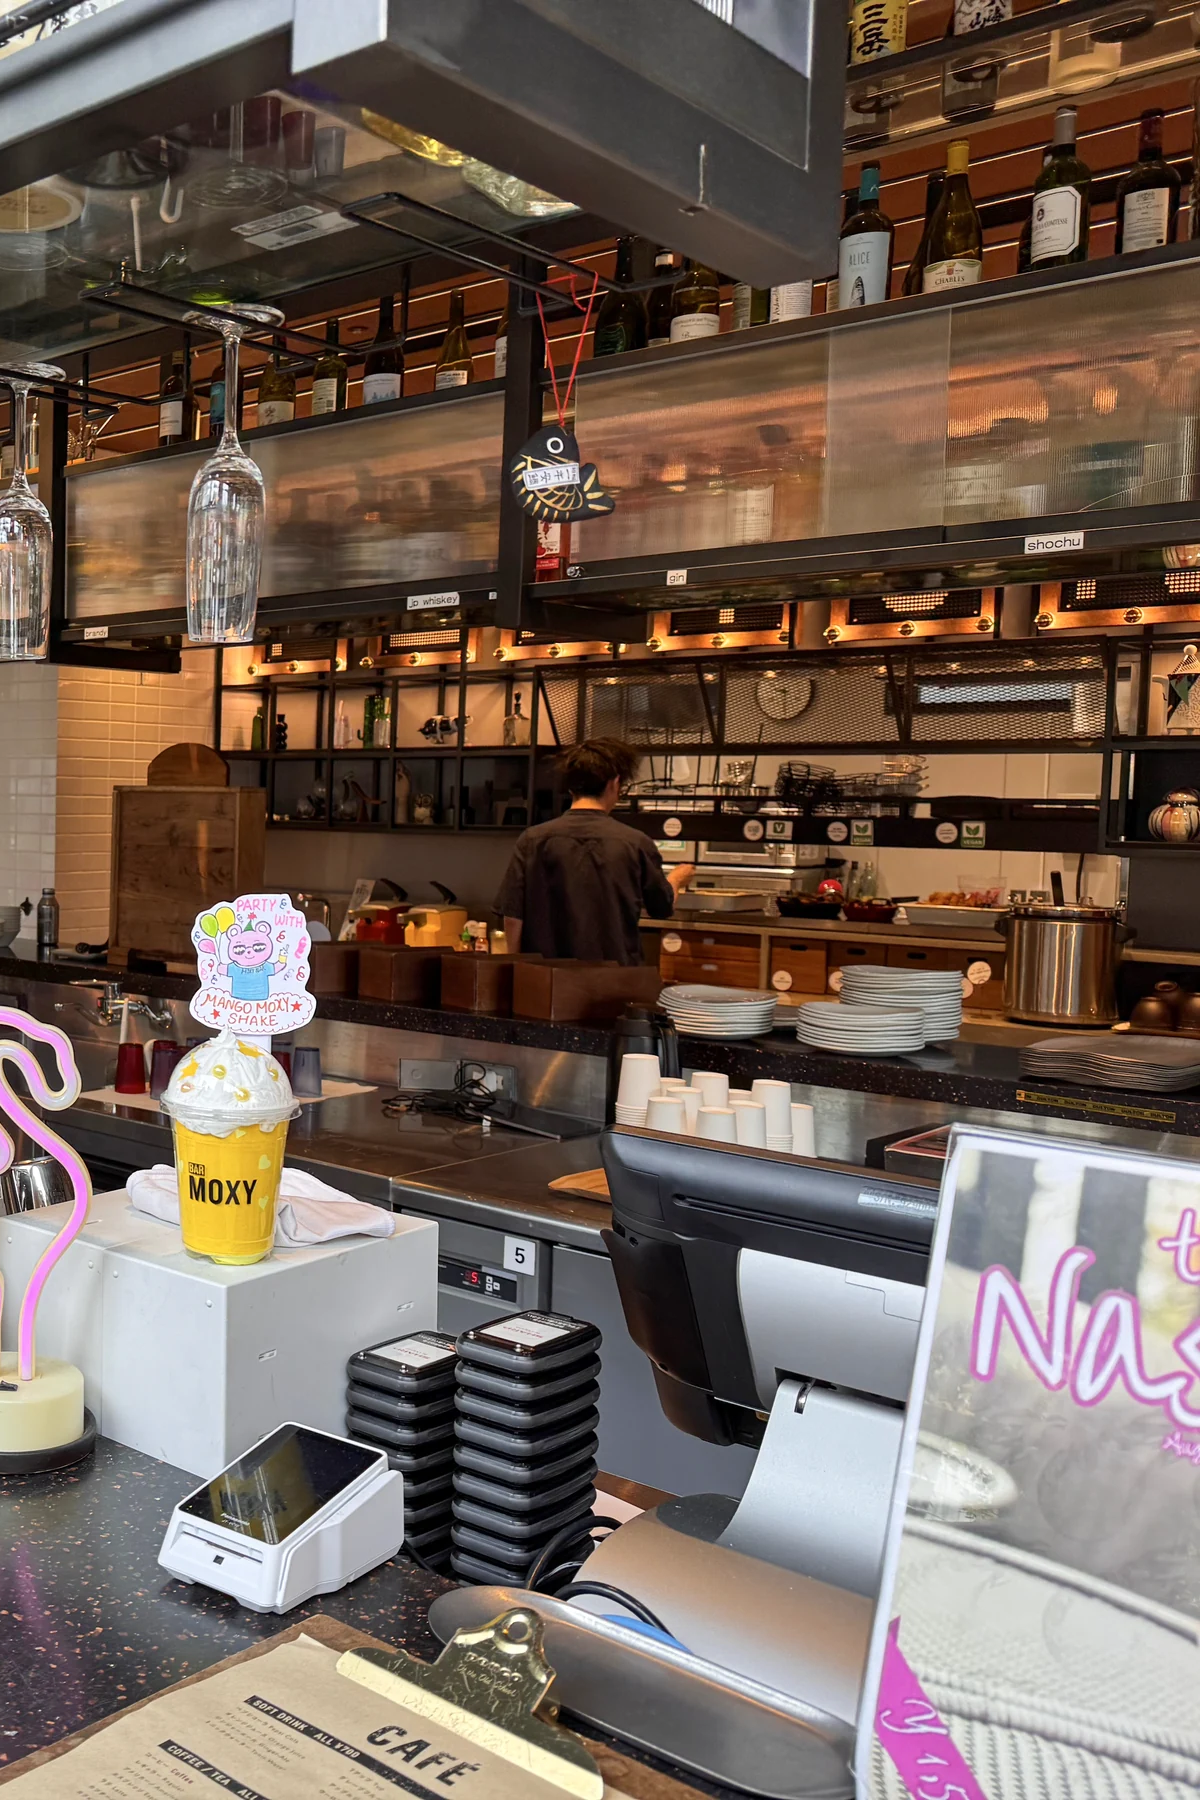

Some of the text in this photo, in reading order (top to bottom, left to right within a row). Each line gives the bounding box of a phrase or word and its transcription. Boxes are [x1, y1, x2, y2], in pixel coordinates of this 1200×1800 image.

[849, 251, 871, 267] ALICE
[1026, 535, 1083, 552] shochu
[668, 572, 687, 585] gin
[408, 594, 459, 609] jp whiskey
[85, 629, 107, 639] brandy
[236, 899, 277, 914] PARTY
[274, 910, 304, 929] WITH
[203, 992, 291, 1015] MANGO MOXY
[227, 1012, 279, 1027] SHAKE
[188, 1162, 205, 1176] BAR
[189, 1178, 258, 1205] MOXY
[515, 1247, 525, 1265] 5
[250, 1699, 361, 1758] SOFT DRINK ALL ¥700
[366, 1725, 483, 1787] CAFÉ
[165, 1744, 205, 1767] COFFEE
[208, 1771, 232, 1785] TEA
[169, 1768, 195, 1784] Coffee
